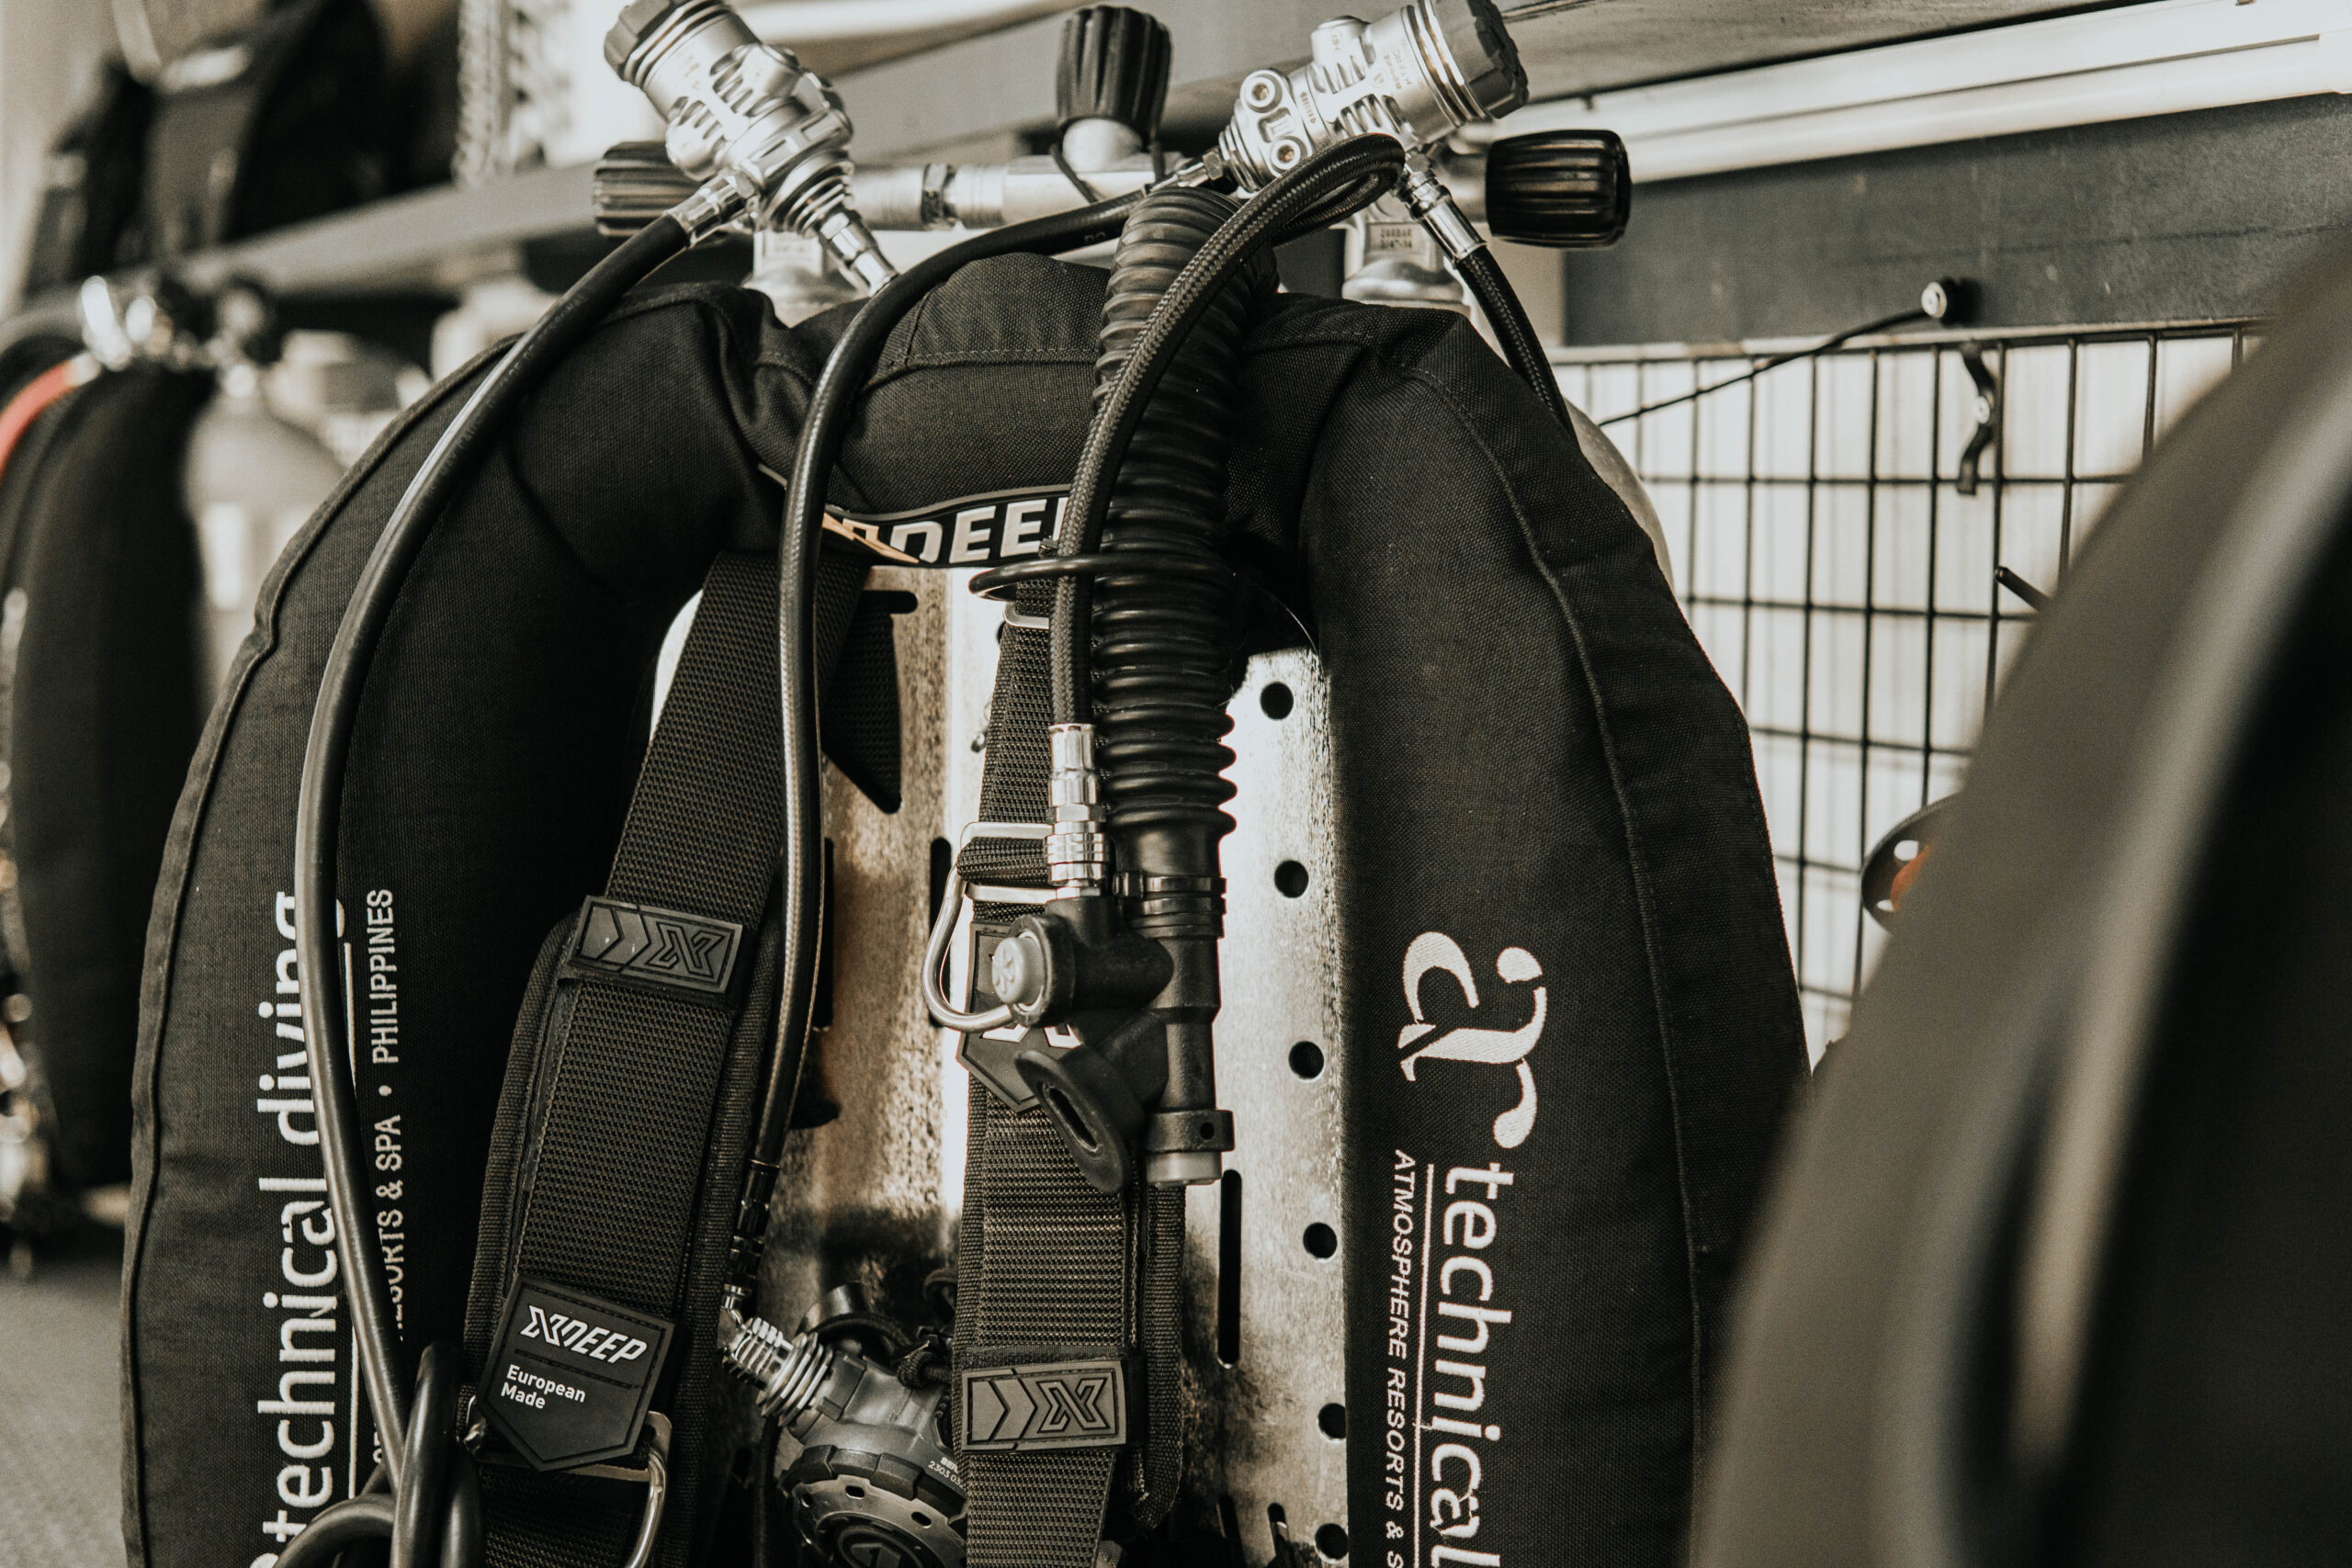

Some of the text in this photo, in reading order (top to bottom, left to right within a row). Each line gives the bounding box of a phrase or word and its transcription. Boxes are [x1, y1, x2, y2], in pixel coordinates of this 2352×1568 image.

[822, 497, 1069, 564] DEE
[367, 889, 399, 1064] PHILIPPINES
[374, 1114, 402, 1171] SPA
[376, 1179, 403, 1200] &
[1388, 1149, 1416, 1359] ATMOSPHERE
[257, 1178, 337, 1542] technical
[520, 1305, 647, 1364] XDEEP
[506, 1364, 586, 1403] European
[1430, 1162, 1514, 1568] technical
[501, 1382, 546, 1409] Made
[1385, 1368, 1406, 1510] RESORTS
[928, 1461, 964, 1489] 2303 03
[1385, 1521, 1404, 1539] &
